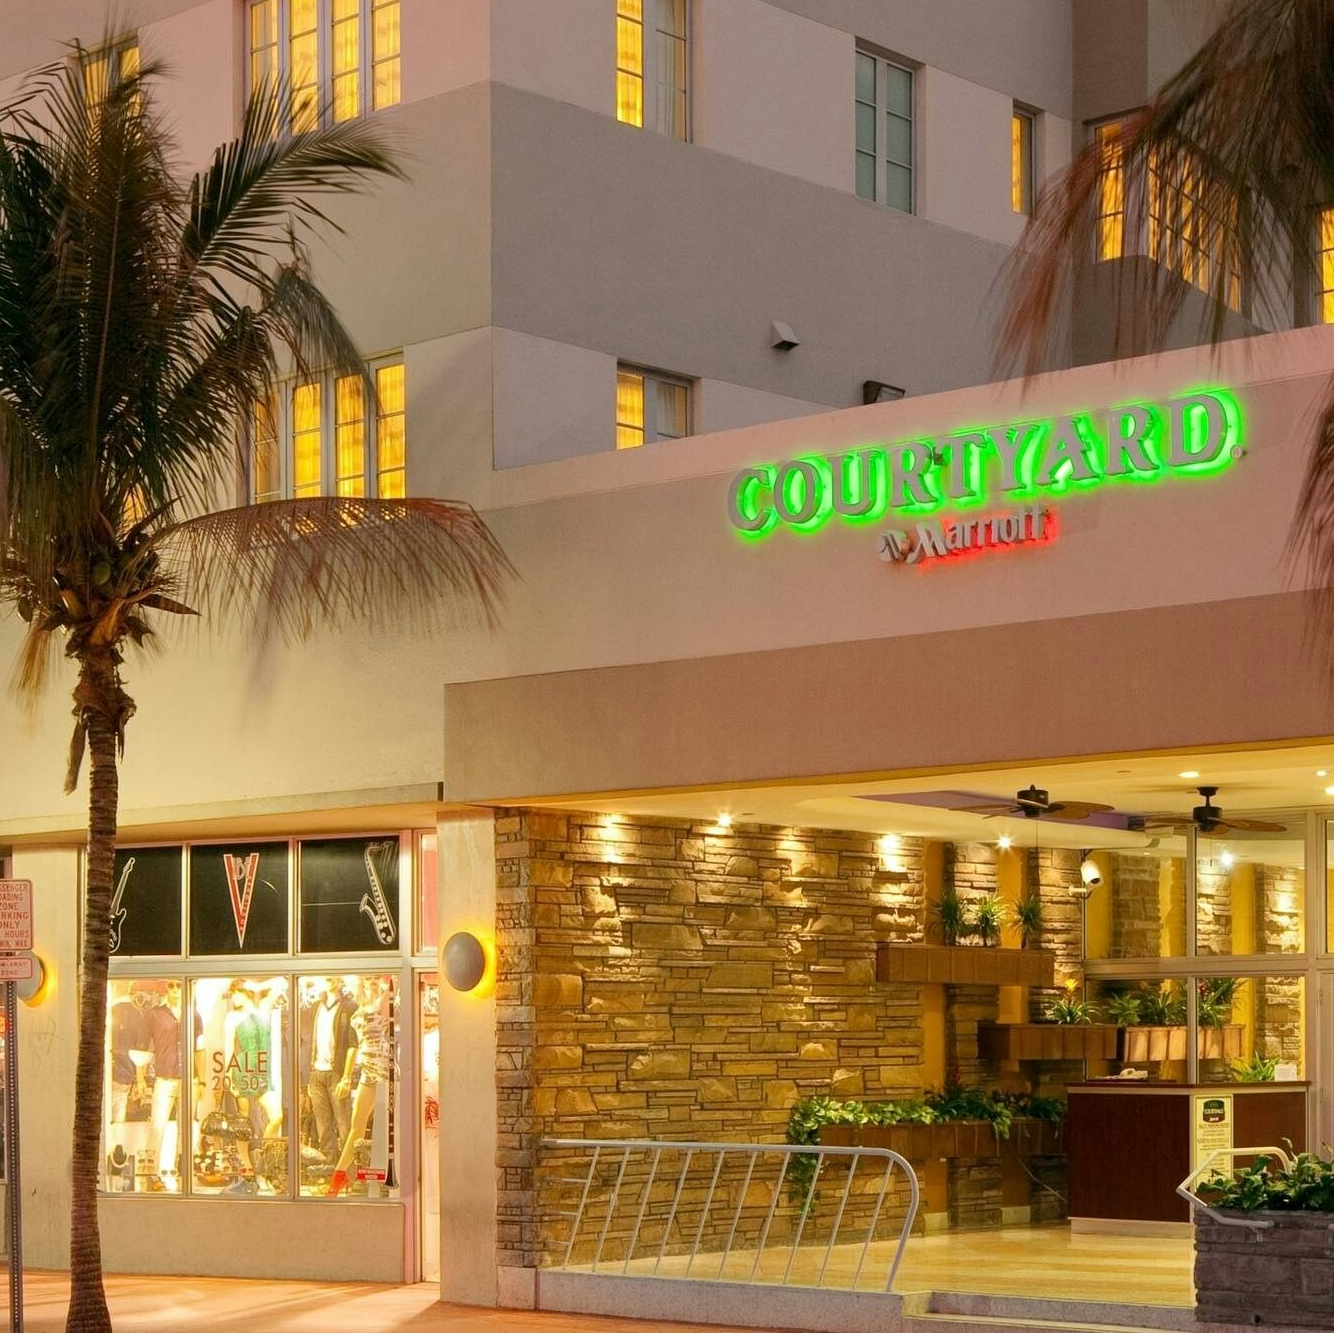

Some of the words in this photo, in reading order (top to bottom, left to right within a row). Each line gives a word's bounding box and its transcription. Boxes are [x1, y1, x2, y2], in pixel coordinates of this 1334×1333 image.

[726, 392, 1241, 533] COURTYARD
[906, 504, 1056, 565] Marriott
[4, 930, 29, 938] HOURS
[212, 1051, 268, 1074] SALE
